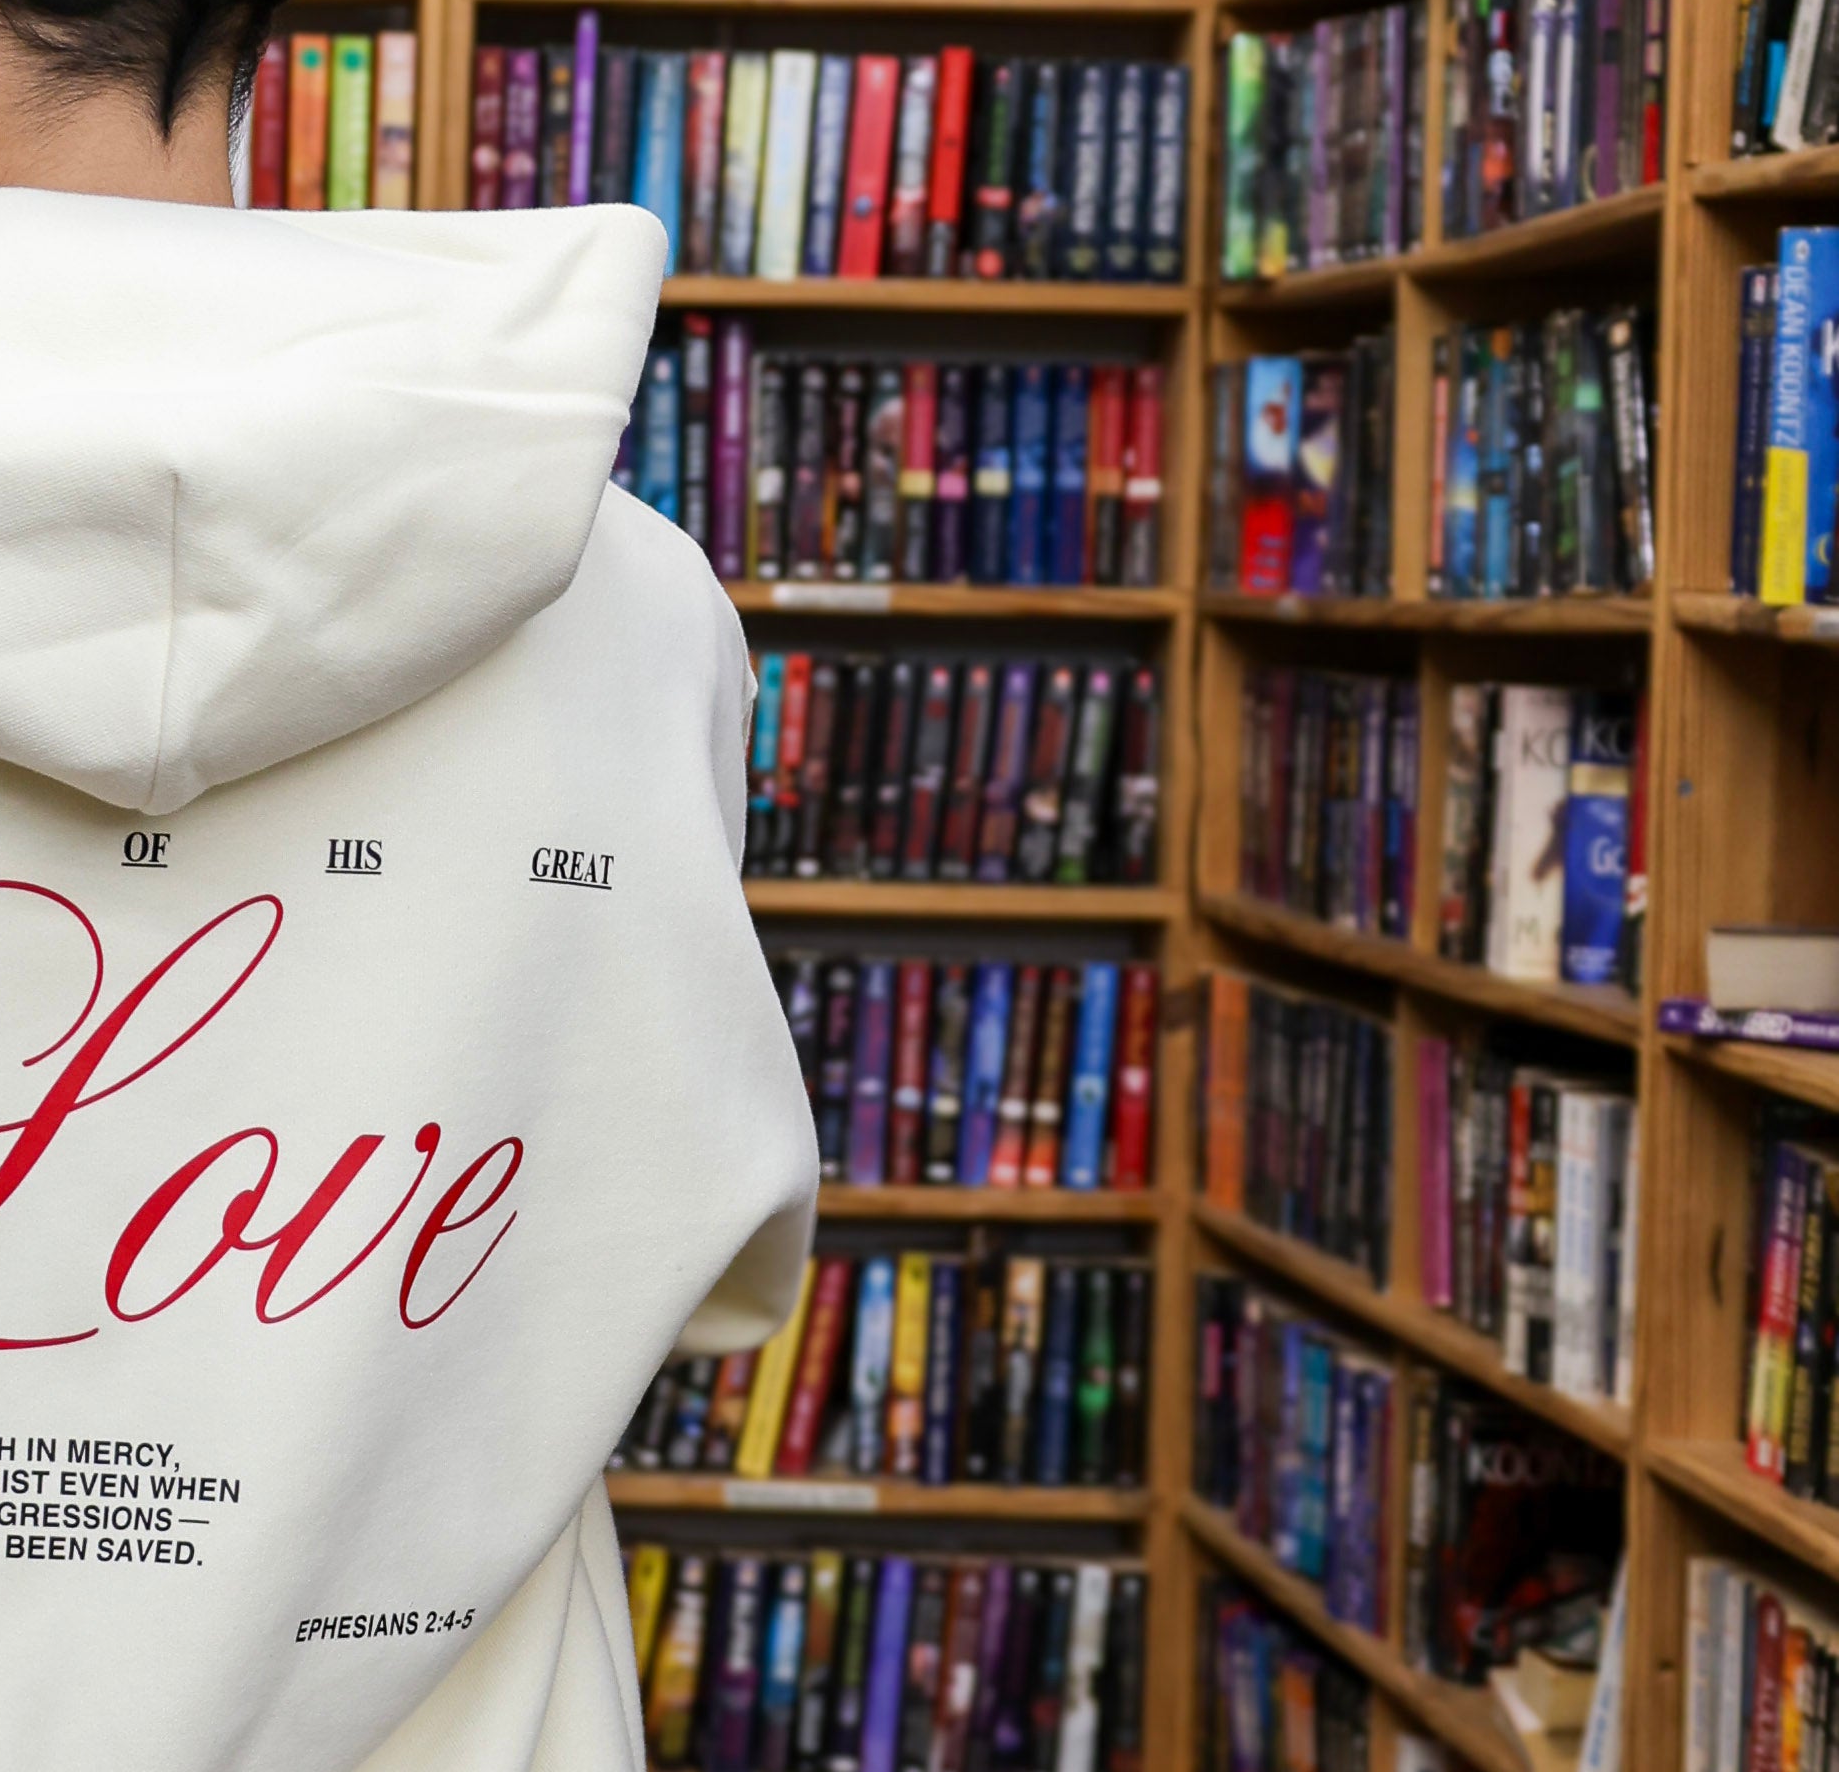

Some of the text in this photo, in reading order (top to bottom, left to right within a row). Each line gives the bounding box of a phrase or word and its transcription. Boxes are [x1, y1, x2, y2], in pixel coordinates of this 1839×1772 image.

[1781, 264, 1808, 337] DEAN
[1773, 341, 1805, 448] KOONTZ
[121, 830, 171, 868] OF
[326, 838, 382, 875] HIS
[530, 847, 615, 890] GREAT
[27, 1437, 56, 1463] IN
[67, 1439, 180, 1473] MERCY,
[60, 1471, 139, 1499] EVEN
[150, 1475, 240, 1503] WHEN
[5, 1534, 88, 1561] BEEN
[96, 1537, 203, 1566] SAVED.
[295, 1608, 476, 1643] EPHESIANS 2:4-5
